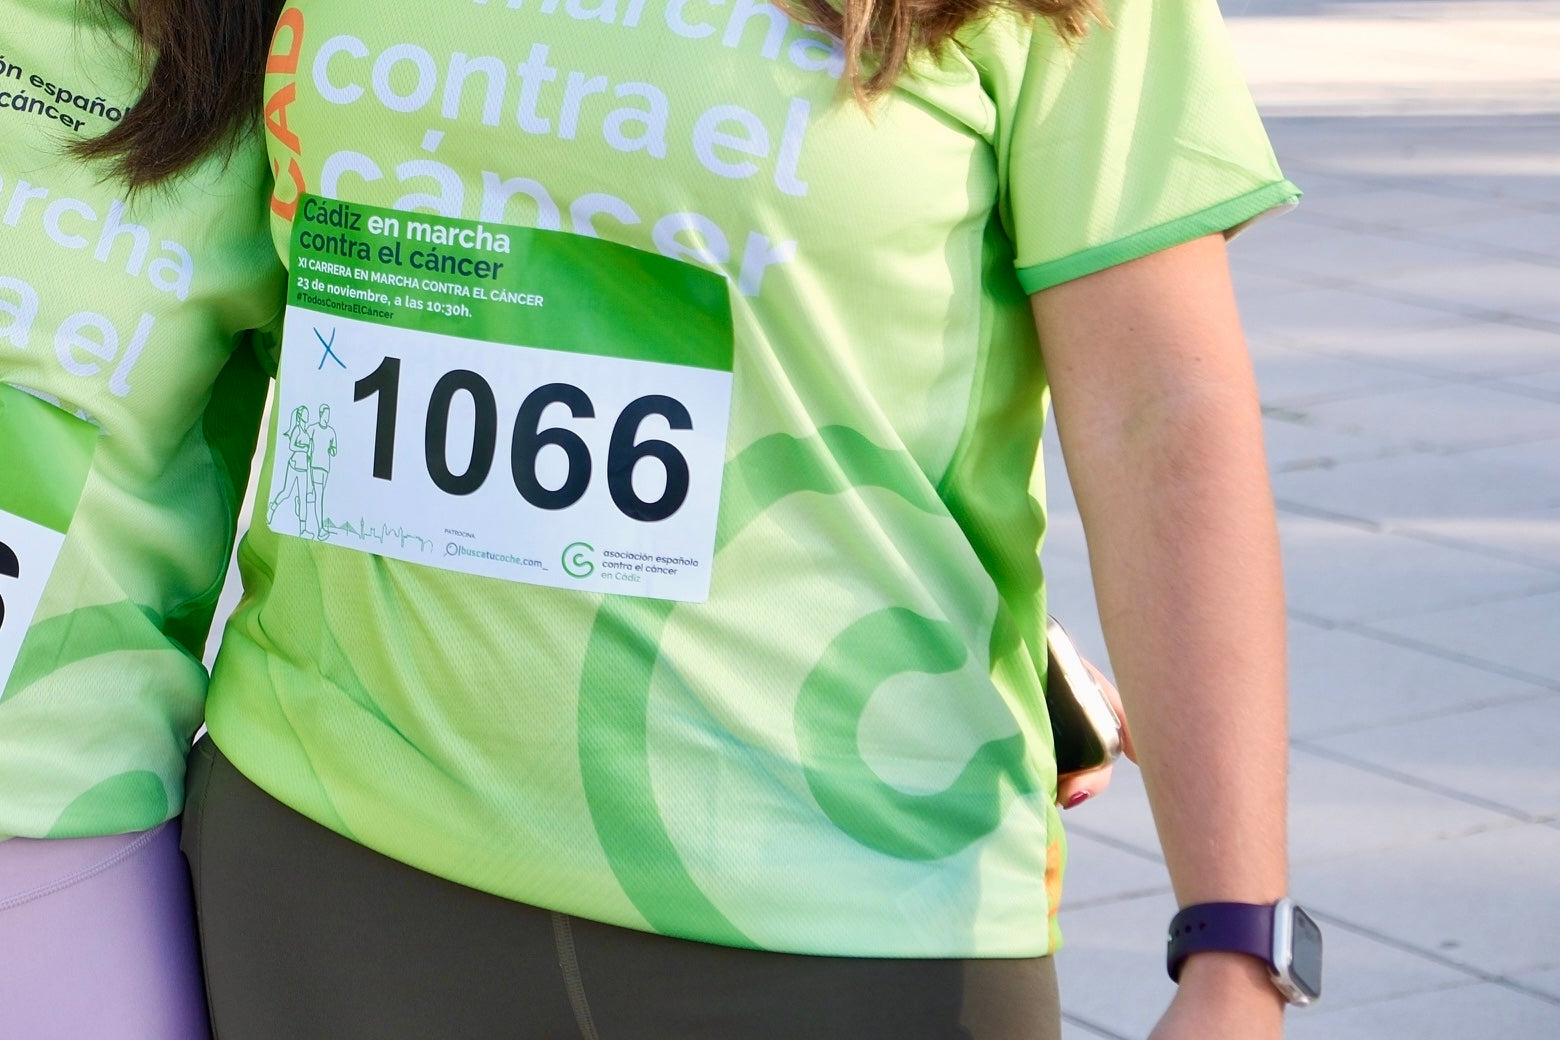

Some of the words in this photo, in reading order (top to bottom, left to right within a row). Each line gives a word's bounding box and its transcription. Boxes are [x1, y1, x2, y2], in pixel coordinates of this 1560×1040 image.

[312, 35, 670, 159] contra
[693, 97, 811, 197] el
[304, 199, 362, 231] Cádiz
[368, 216, 399, 237] en
[407, 221, 511, 254] marcha
[299, 231, 371, 261] contra
[378, 242, 402, 266] el
[409, 247, 504, 280] cáncer
[296, 292, 395, 320] #TodosContraElCáncer
[297, 277, 309, 290] 23
[312, 278, 325, 292] de
[327, 283, 391, 306] noviembre,
[394, 296, 402, 306] a
[405, 295, 423, 310] las
[427, 301, 472, 318] 10:30h.
[298, 257, 307, 268] XI
[309, 259, 352, 278] CARRERA
[355, 268, 369, 281] EN
[371, 271, 419, 290] MARCHA
[422, 280, 470, 298] CONTRA
[473, 287, 487, 300] EL
[490, 288, 544, 307] CÁNCER
[54, 306, 156, 398] el
[353, 356, 693, 522] 1066
[601, 572, 614, 581] en
[615, 571, 641, 583] Cádiz
[602, 560, 633, 572] contra
[634, 562, 644, 572] el
[645, 563, 678, 576] cáncer
[603, 549, 654, 563] asociación
[656, 555, 699, 568] española
